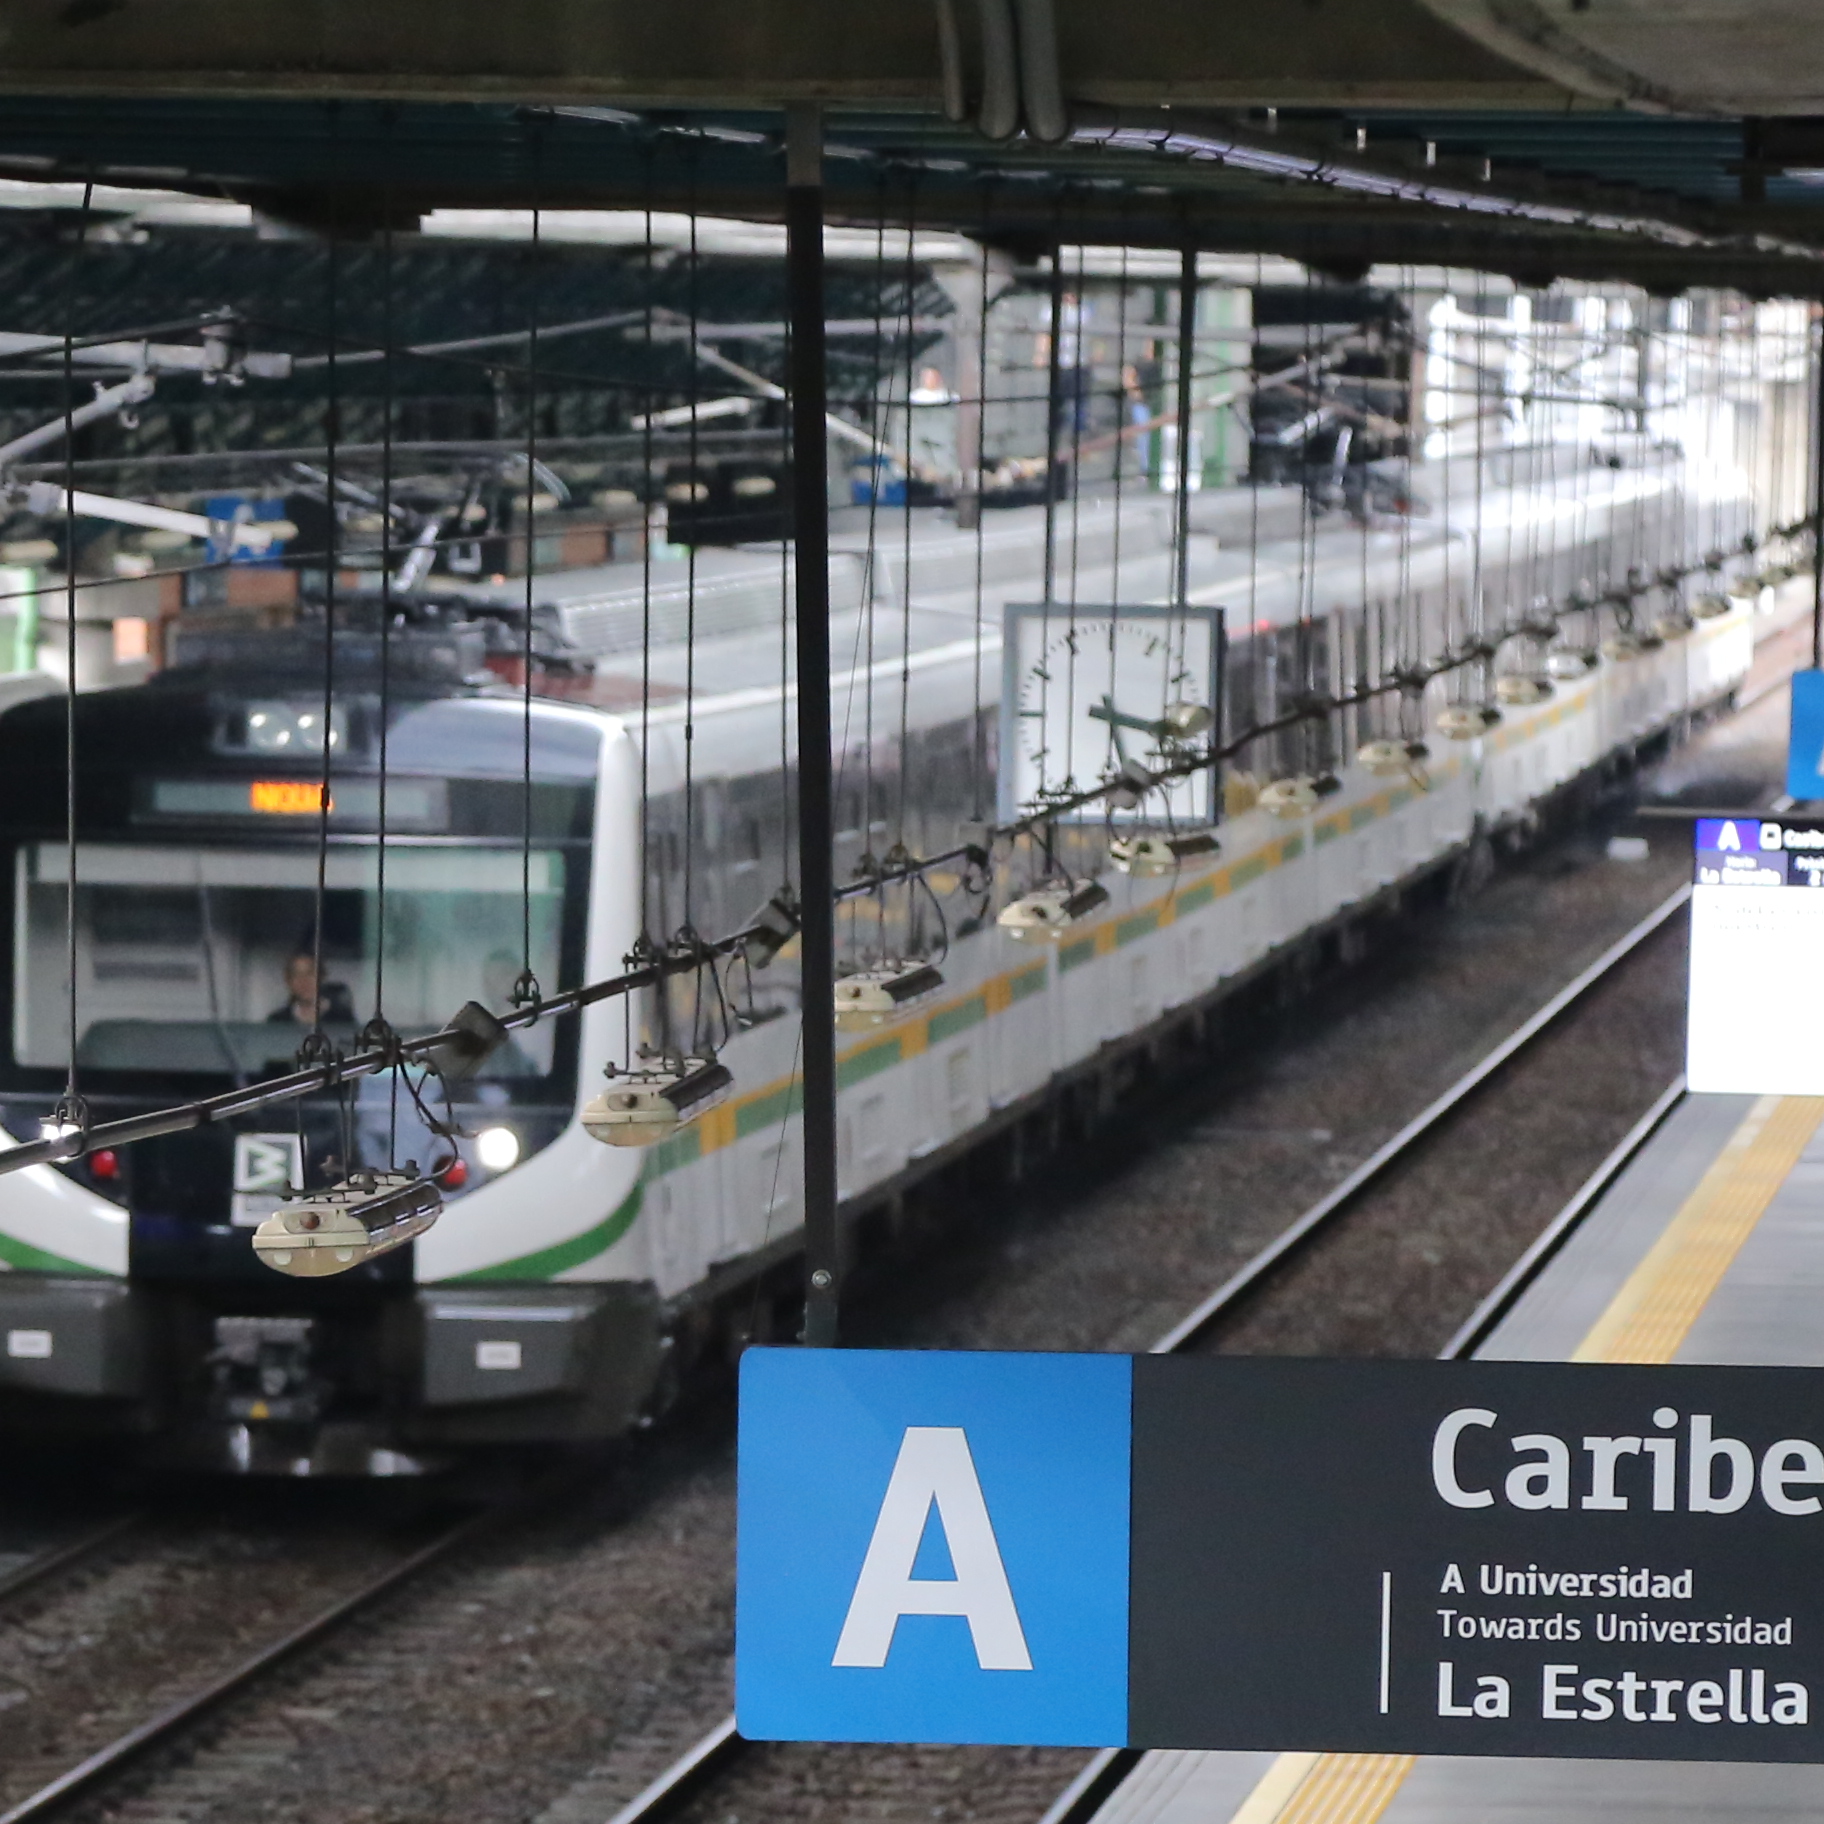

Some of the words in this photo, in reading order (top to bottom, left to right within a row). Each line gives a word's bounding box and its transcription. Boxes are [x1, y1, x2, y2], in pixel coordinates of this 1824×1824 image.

[1717, 821, 1741, 850] A
[831, 1426, 1034, 1670] A
[1439, 1563, 1466, 1594] A
[1480, 1564, 1693, 1599] Universidad
[1436, 1609, 1582, 1641] Towards
[1596, 1613, 1793, 1645] Universidad
[1437, 1661, 1510, 1719] La
[1542, 1664, 1809, 1725] Estrella
